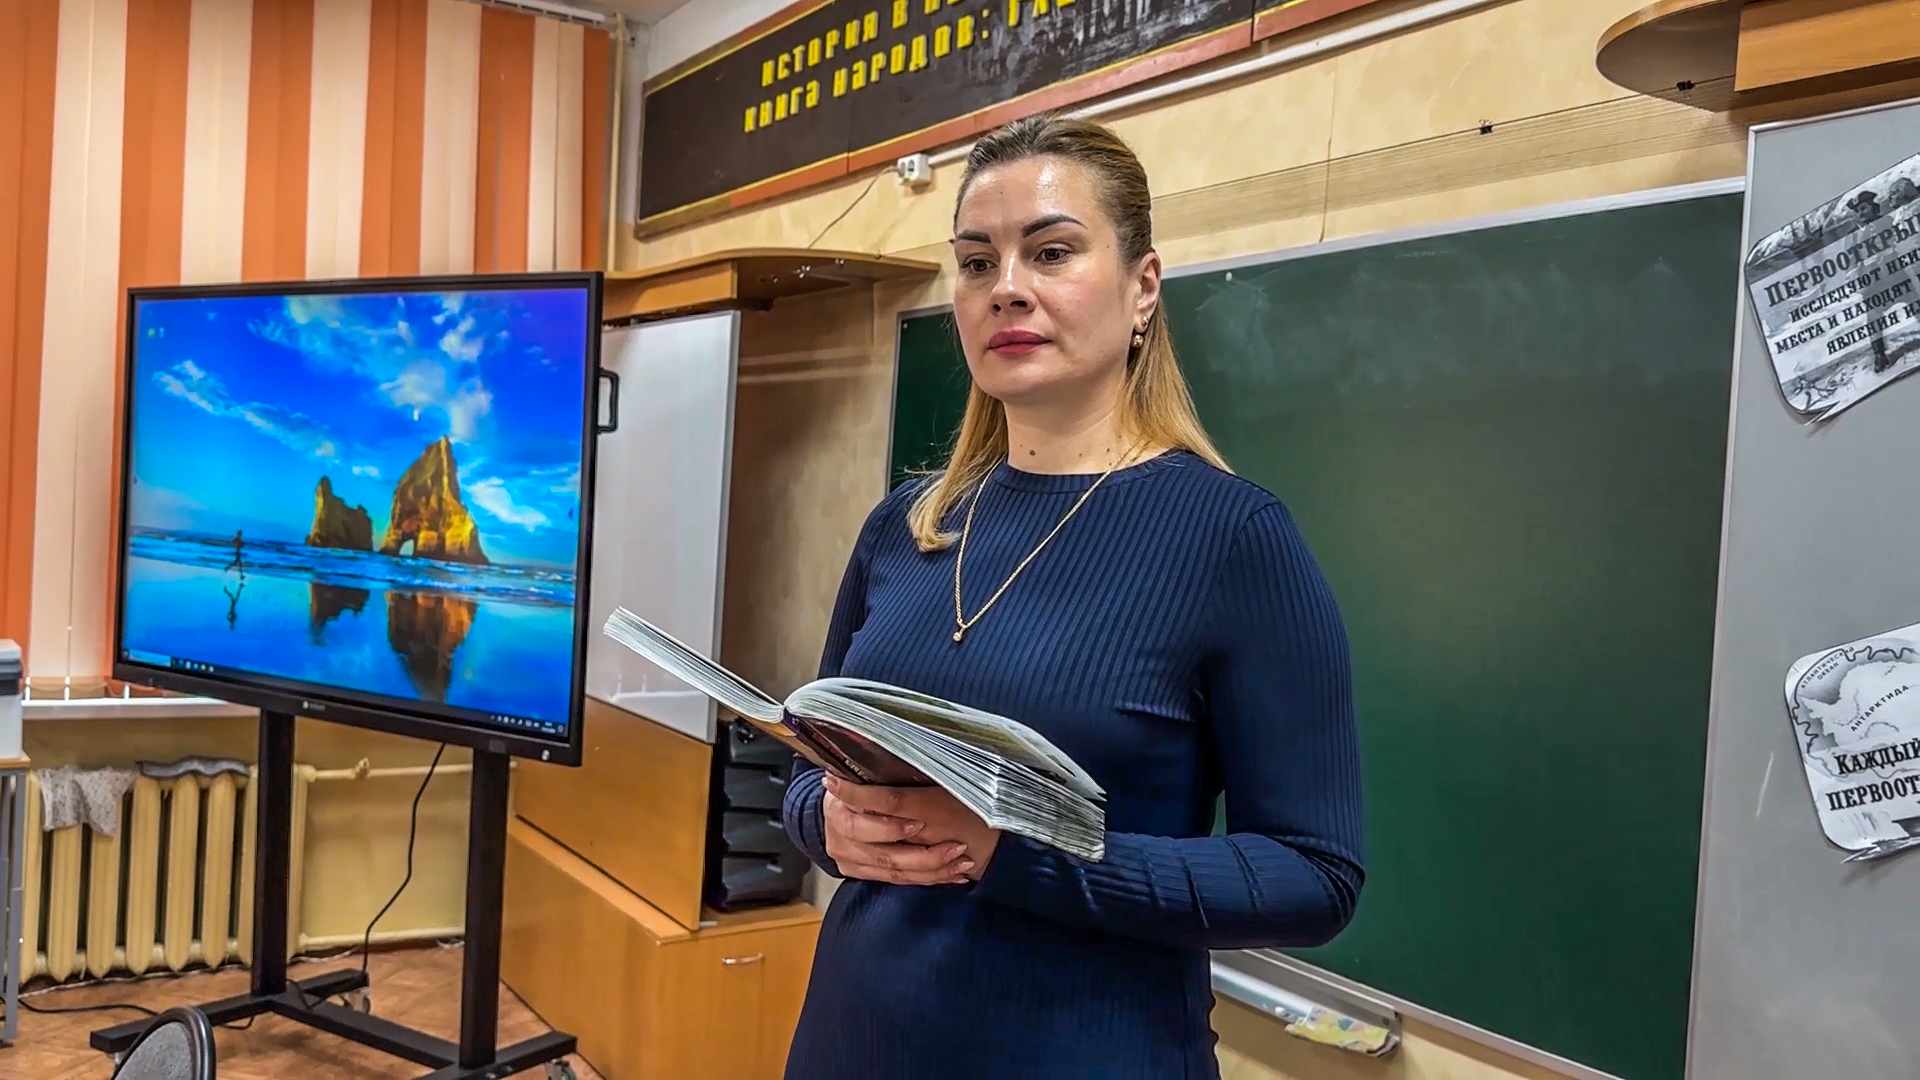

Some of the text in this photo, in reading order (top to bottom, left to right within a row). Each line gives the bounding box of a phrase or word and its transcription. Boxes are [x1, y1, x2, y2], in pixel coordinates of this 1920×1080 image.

[761, 0, 908, 87] ИСТОРИЯ В
[1790, 268, 1881, 323] ИССЛЕДУЮТ
[1885, 247, 1920, 276] НЕИ
[1775, 323, 1824, 354] МЕСТА
[1828, 315, 1841, 331] И
[1842, 279, 1913, 323] НАХОДЯТ
[1826, 311, 1901, 355] ЯВЛЕНИЯ
[1817, 662, 1839, 680] ОКЕАН
[1850, 684, 1909, 732] АНТАРКТИДА
